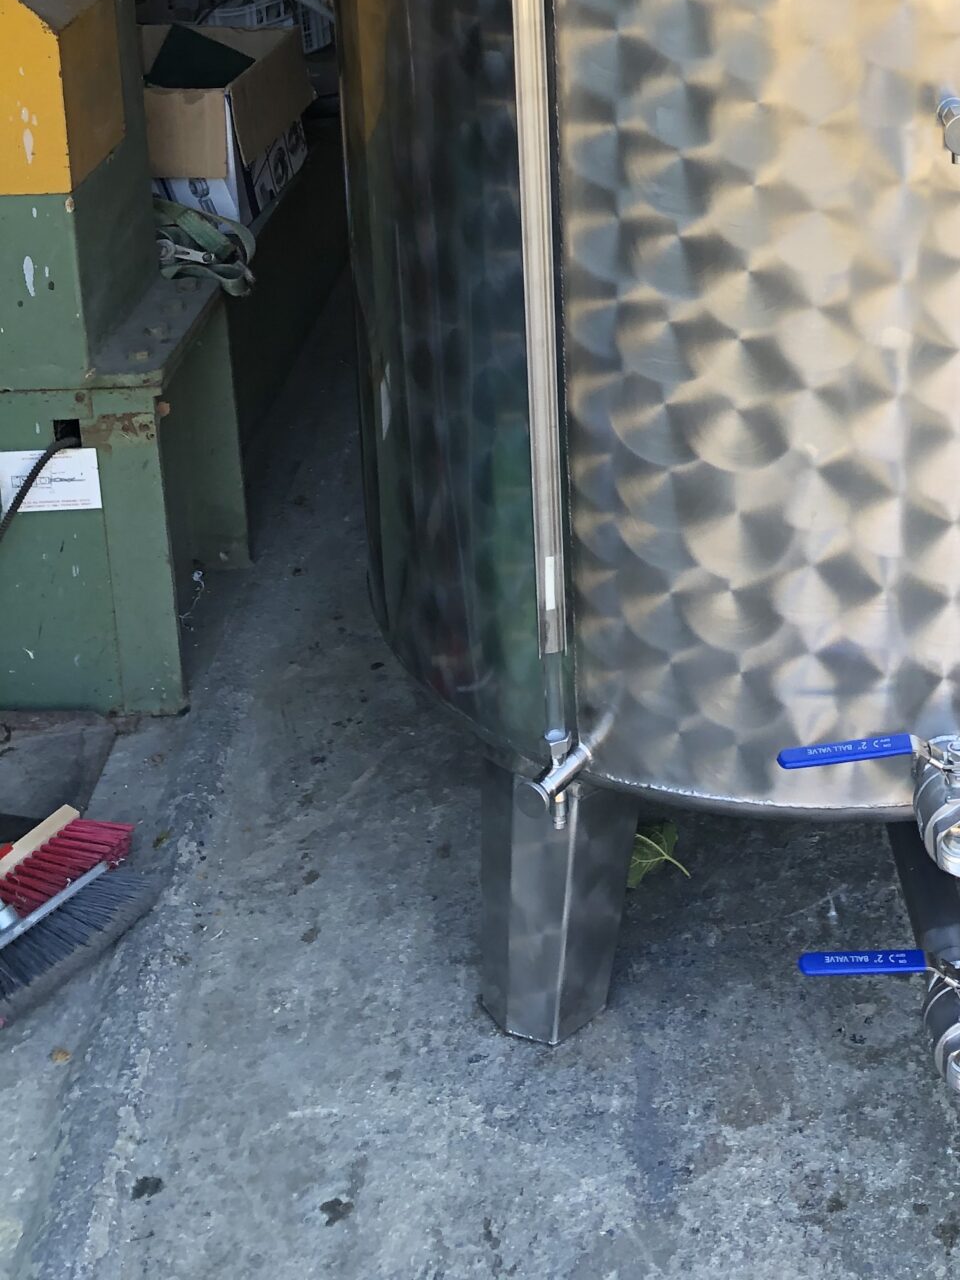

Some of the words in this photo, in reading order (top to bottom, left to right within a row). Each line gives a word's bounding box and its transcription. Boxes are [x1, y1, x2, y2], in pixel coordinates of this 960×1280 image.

[807, 746, 833, 755] VALVE
[833, 744, 853, 752] BALL
[824, 955, 849, 963] VALVE
[849, 955, 869, 963] BALL
